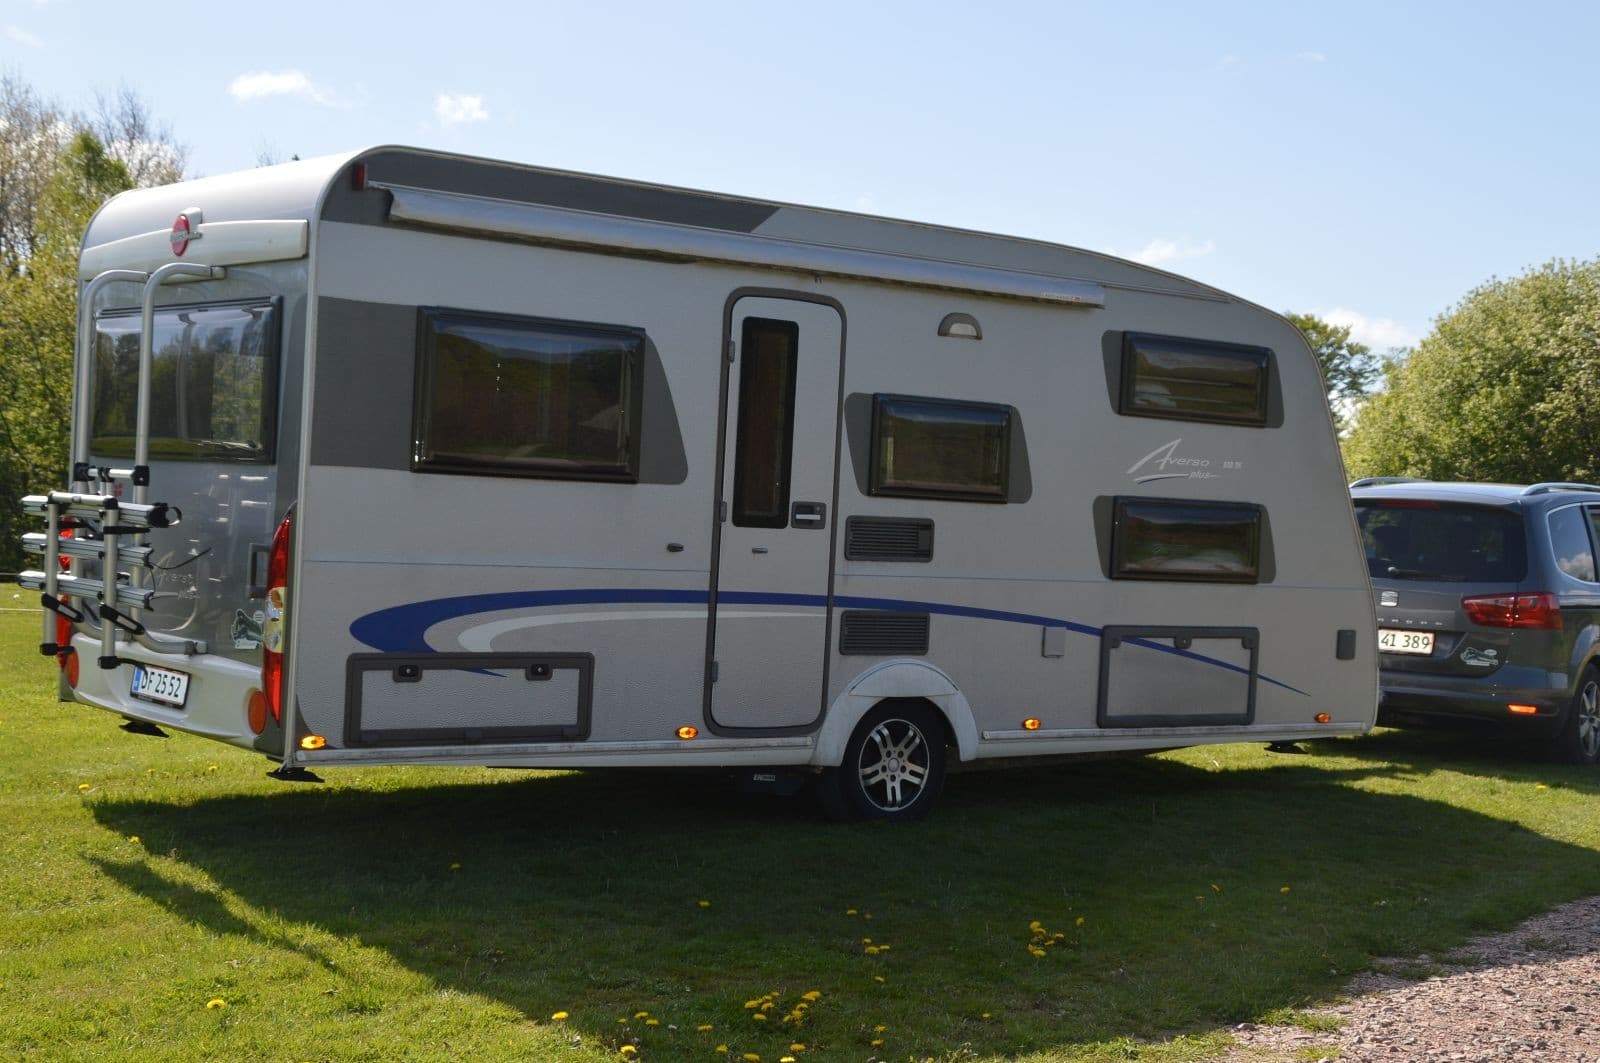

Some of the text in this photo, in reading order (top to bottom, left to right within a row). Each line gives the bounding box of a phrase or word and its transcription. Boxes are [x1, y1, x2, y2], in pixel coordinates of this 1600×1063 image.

[1126, 438, 1210, 474] Averso
[1381, 633, 1430, 649] 41 389
